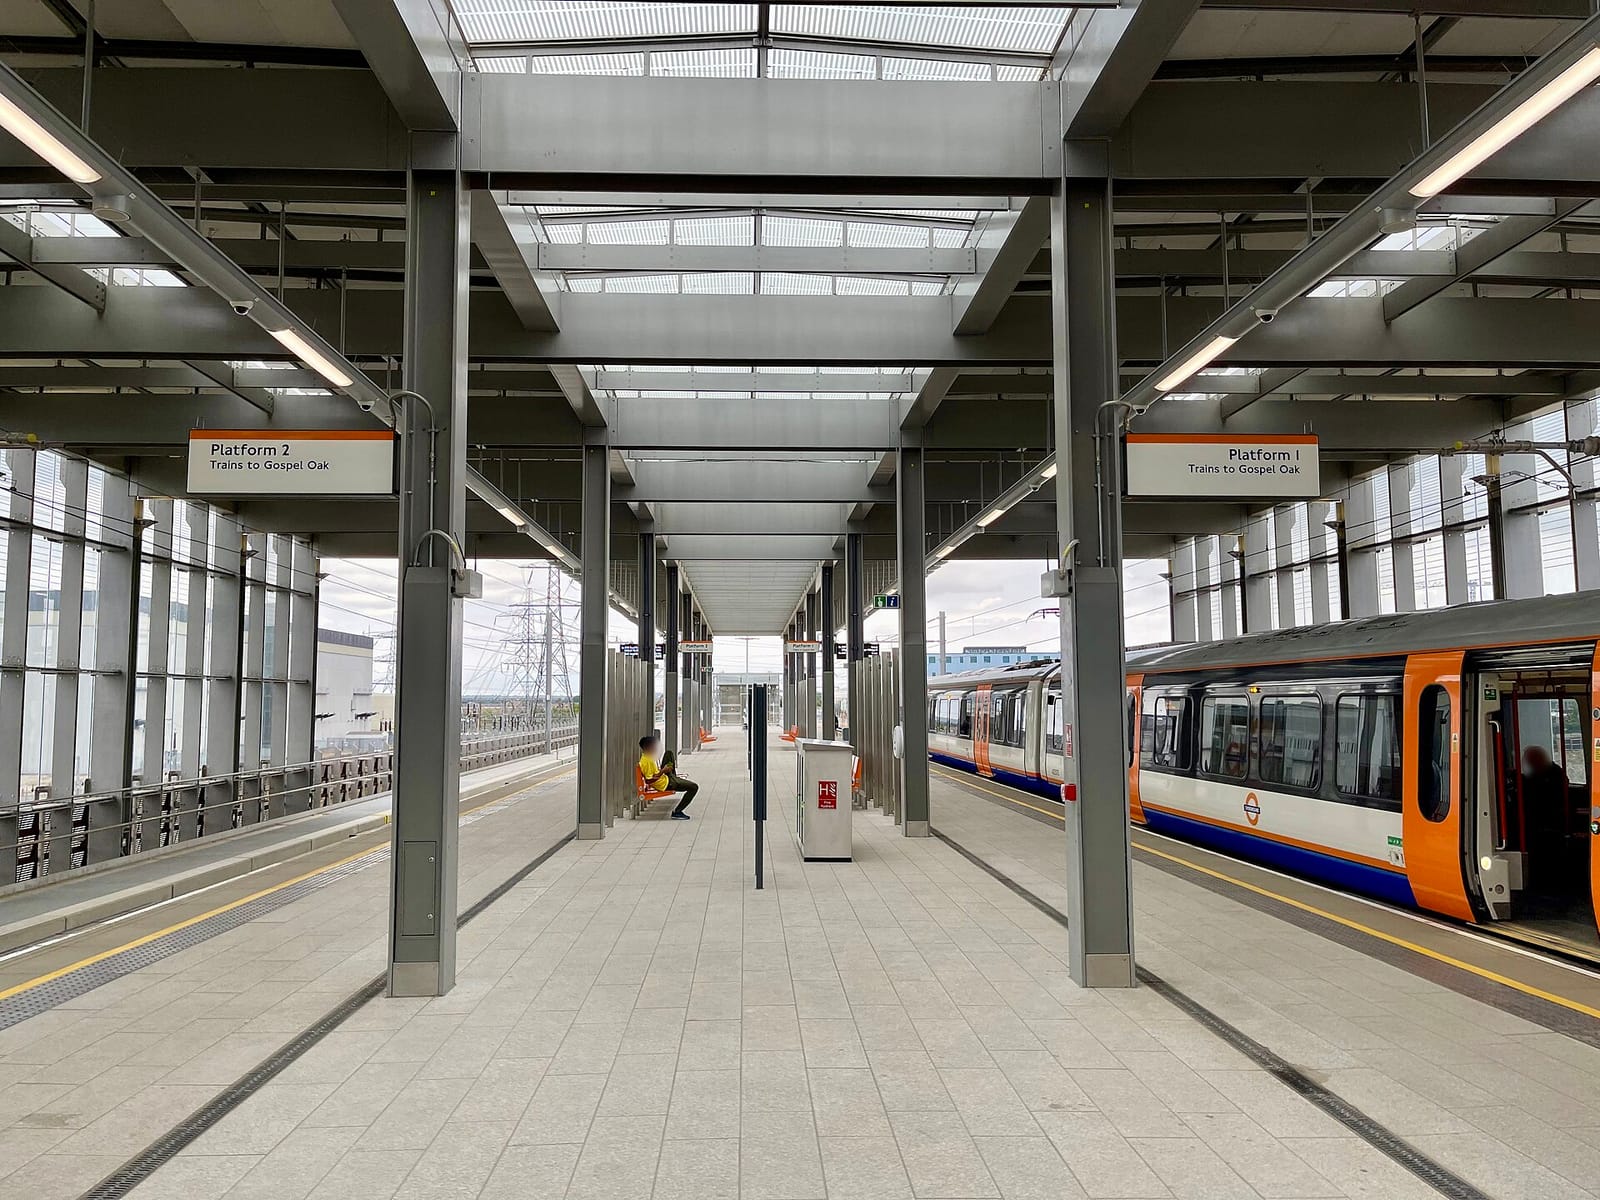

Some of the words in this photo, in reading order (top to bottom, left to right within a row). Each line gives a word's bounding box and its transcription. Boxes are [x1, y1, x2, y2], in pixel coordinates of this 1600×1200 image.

[211, 443, 277, 456] Platform
[281, 444, 290, 456] 2
[1229, 449, 1291, 461] Platform
[210, 460, 243, 470] Trains
[247, 461, 260, 470] to
[263, 460, 304, 472] Gospel
[307, 460, 329, 470] Oak
[1188, 464, 1220, 474] Trains
[1223, 465, 1236, 474] to
[1238, 464, 1277, 476] Gospel
[1279, 465, 1301, 475] Oak
[819, 783, 829, 796] H
